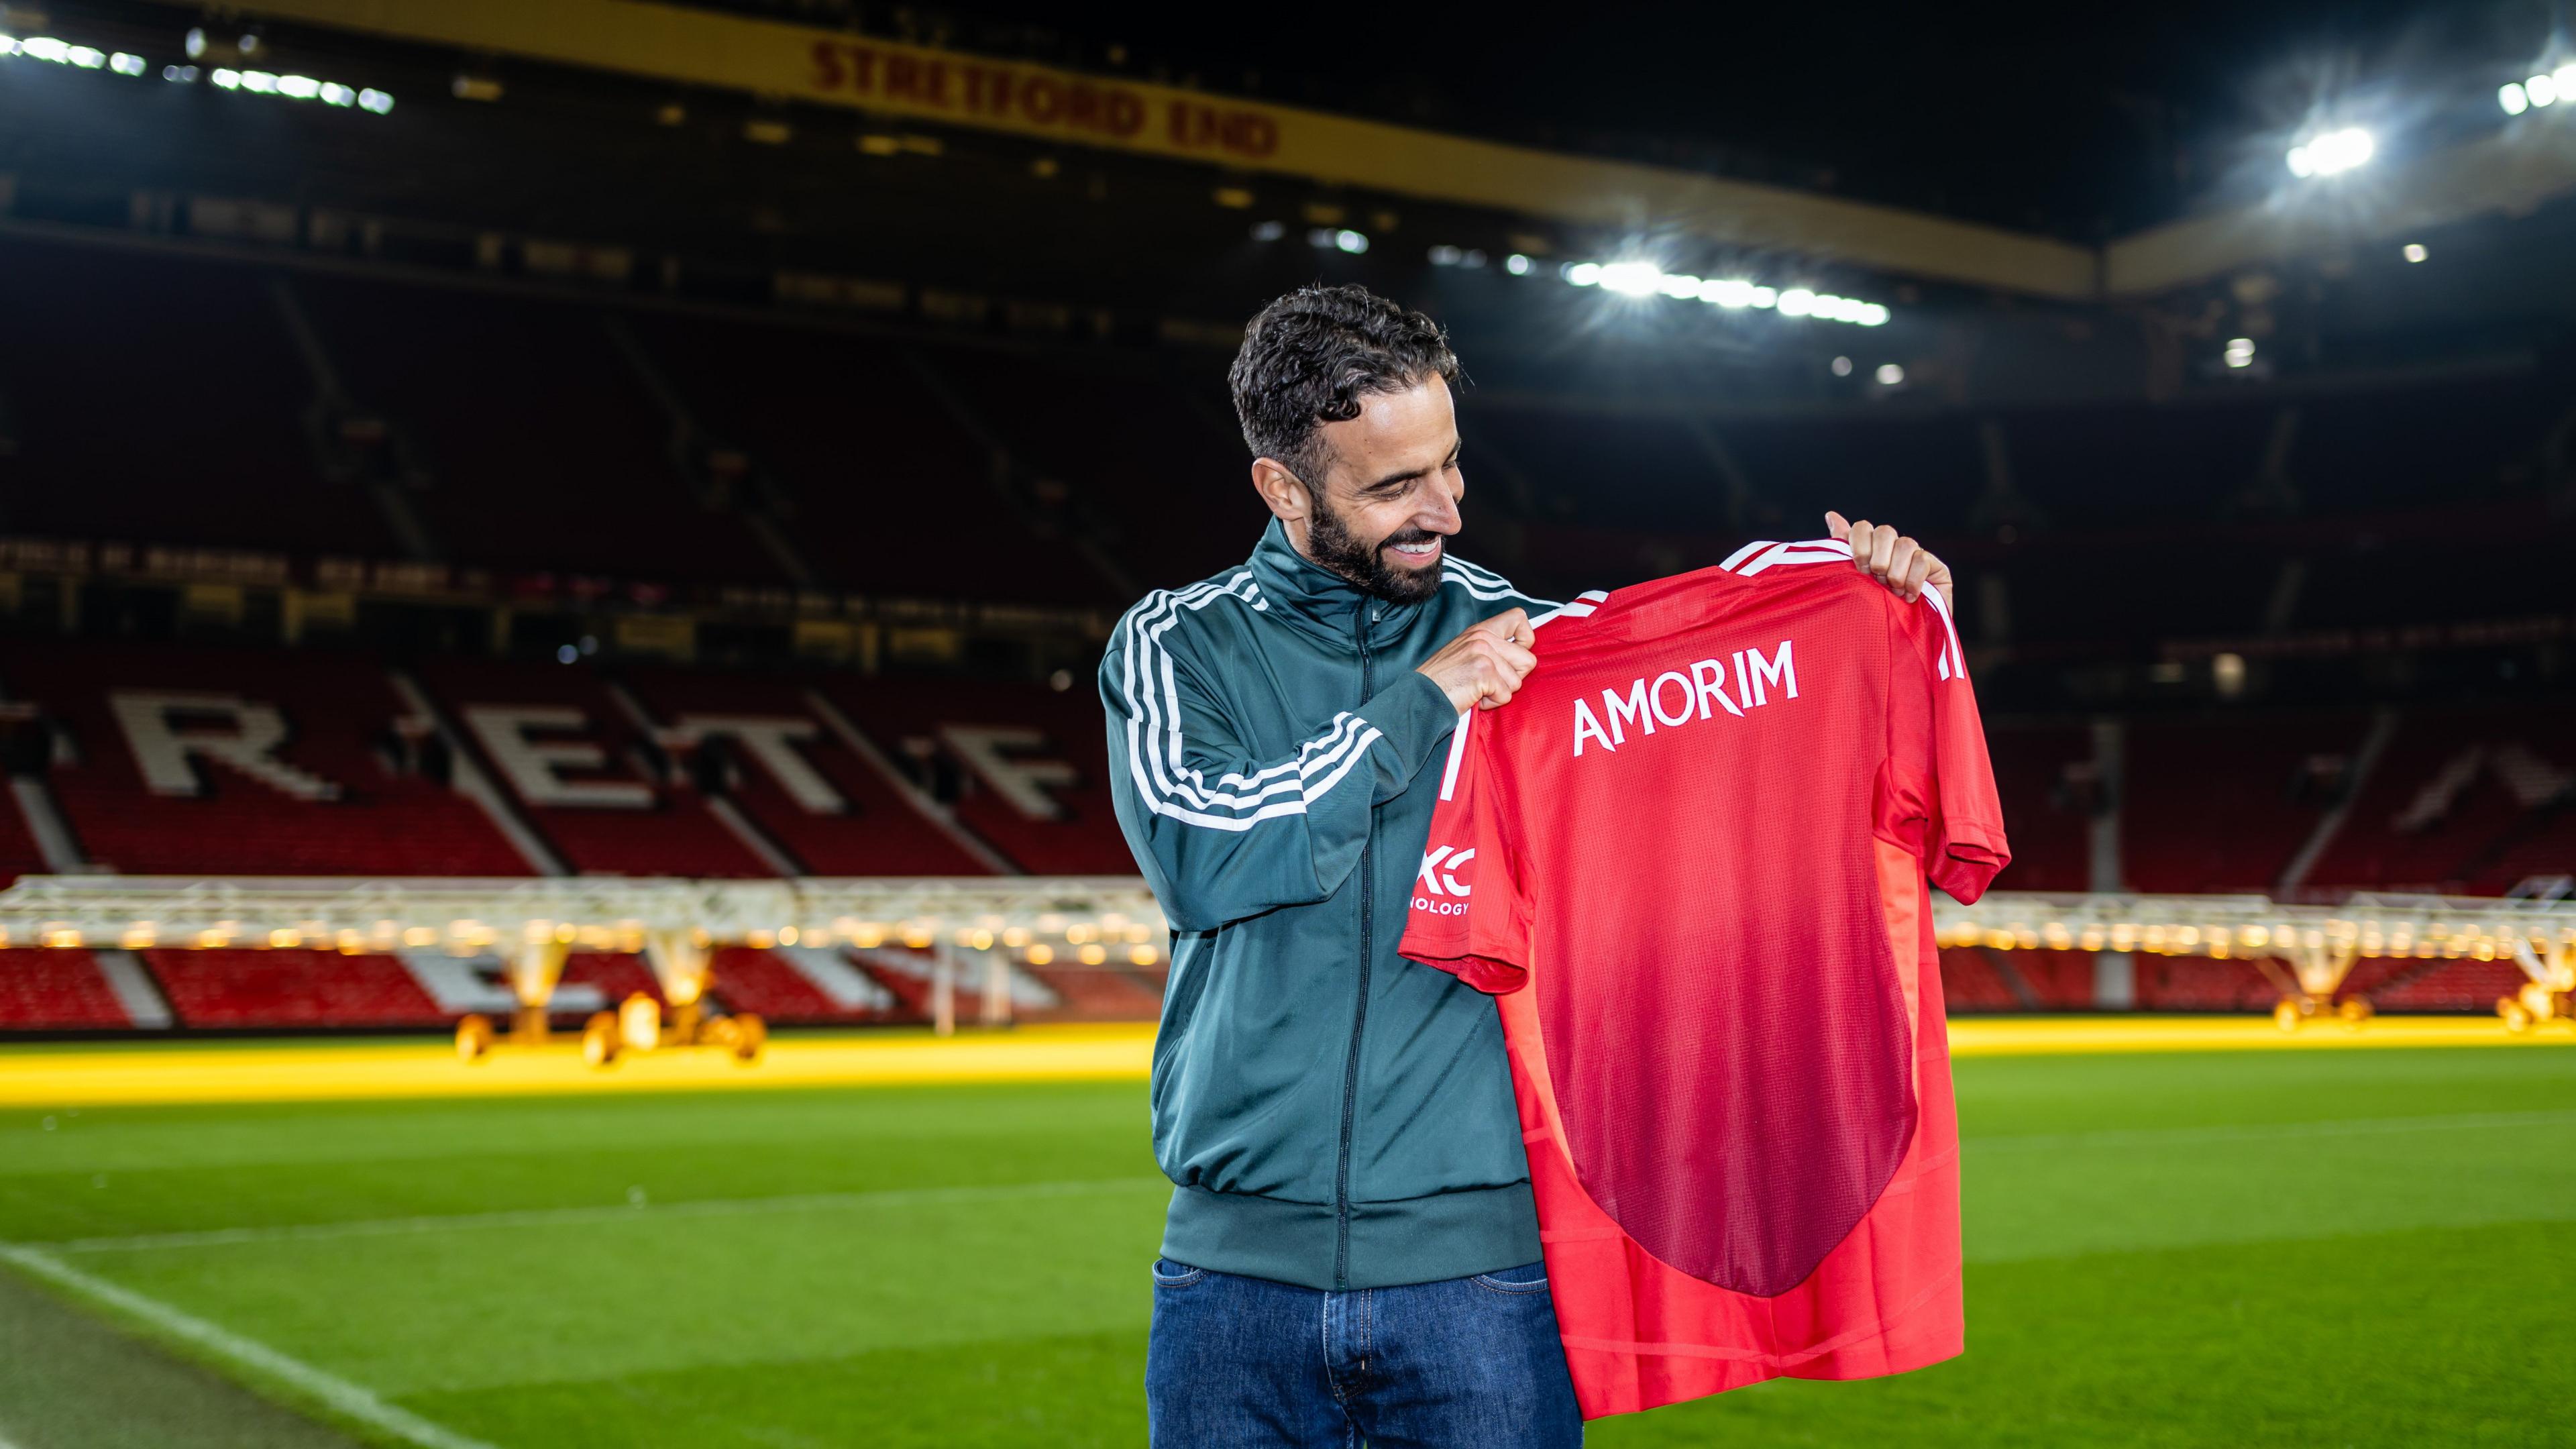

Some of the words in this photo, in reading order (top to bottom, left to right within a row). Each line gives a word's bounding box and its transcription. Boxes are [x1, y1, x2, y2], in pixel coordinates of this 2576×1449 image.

[811, 40, 1145, 141] STRETFORD
[1169, 100, 1279, 159] END
[1574, 640, 1799, 757] AMORIM
